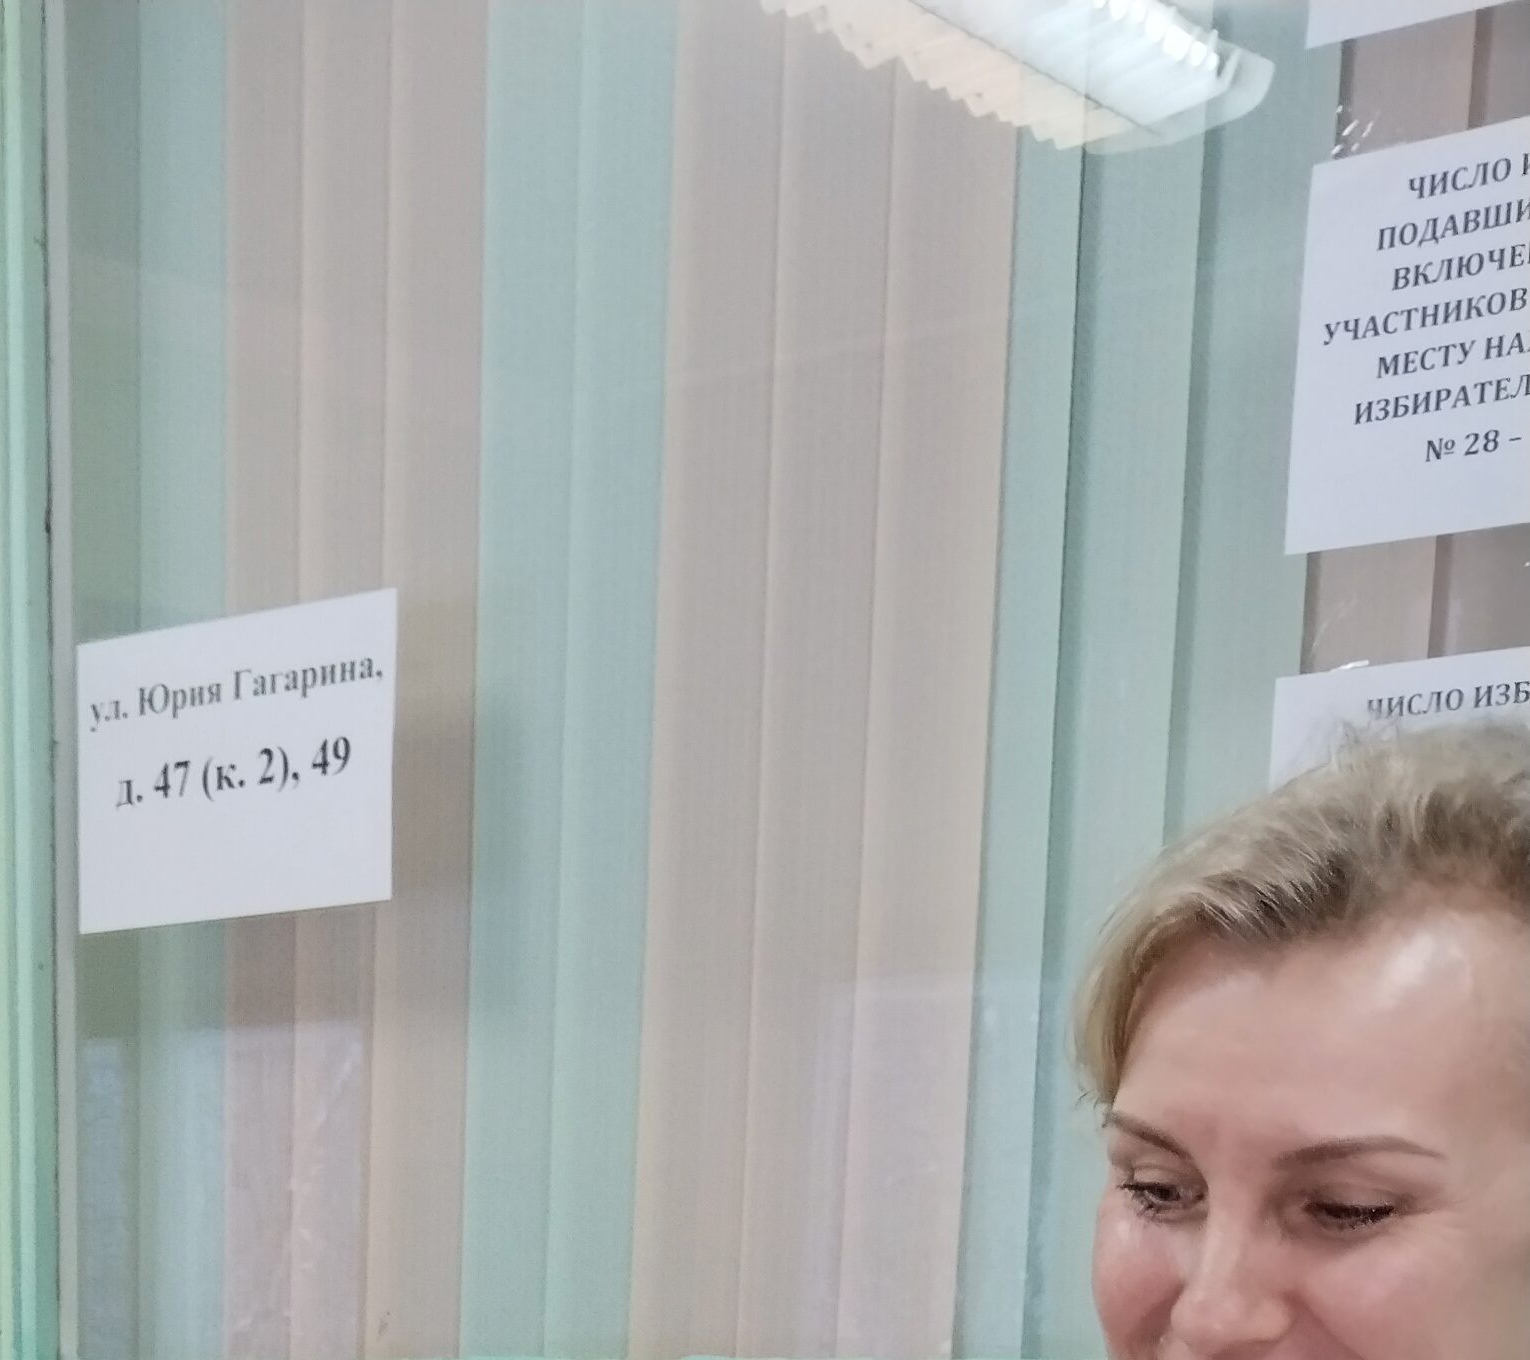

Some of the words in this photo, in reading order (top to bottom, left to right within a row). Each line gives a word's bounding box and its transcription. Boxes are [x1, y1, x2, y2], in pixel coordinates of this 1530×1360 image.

[1408, 157, 1512, 200] ЧИСЛО
[1392, 243, 1530, 291] ВКЛЮЧЕ
[1323, 287, 1528, 346] УЧАСТНИКОВ
[1376, 339, 1477, 379] МЕСТУ
[1484, 332, 1530, 360] НА
[1353, 373, 1530, 425] ИЗБИРАТЕЛ
[1425, 437, 1456, 462] №
[1464, 429, 1500, 456] 28
[90, 700, 129, 733] ул.
[138, 683, 223, 719] Юрия
[232, 656, 384, 701] Гагарина,
[1367, 688, 1465, 721] ЧИСЛО
[1473, 680, 1530, 709] ИЗБ
[115, 780, 144, 811] д.
[153, 761, 191, 801] 47
[202, 756, 247, 802] (к.
[258, 746, 301, 793] 2),
[311, 736, 353, 777] 49
